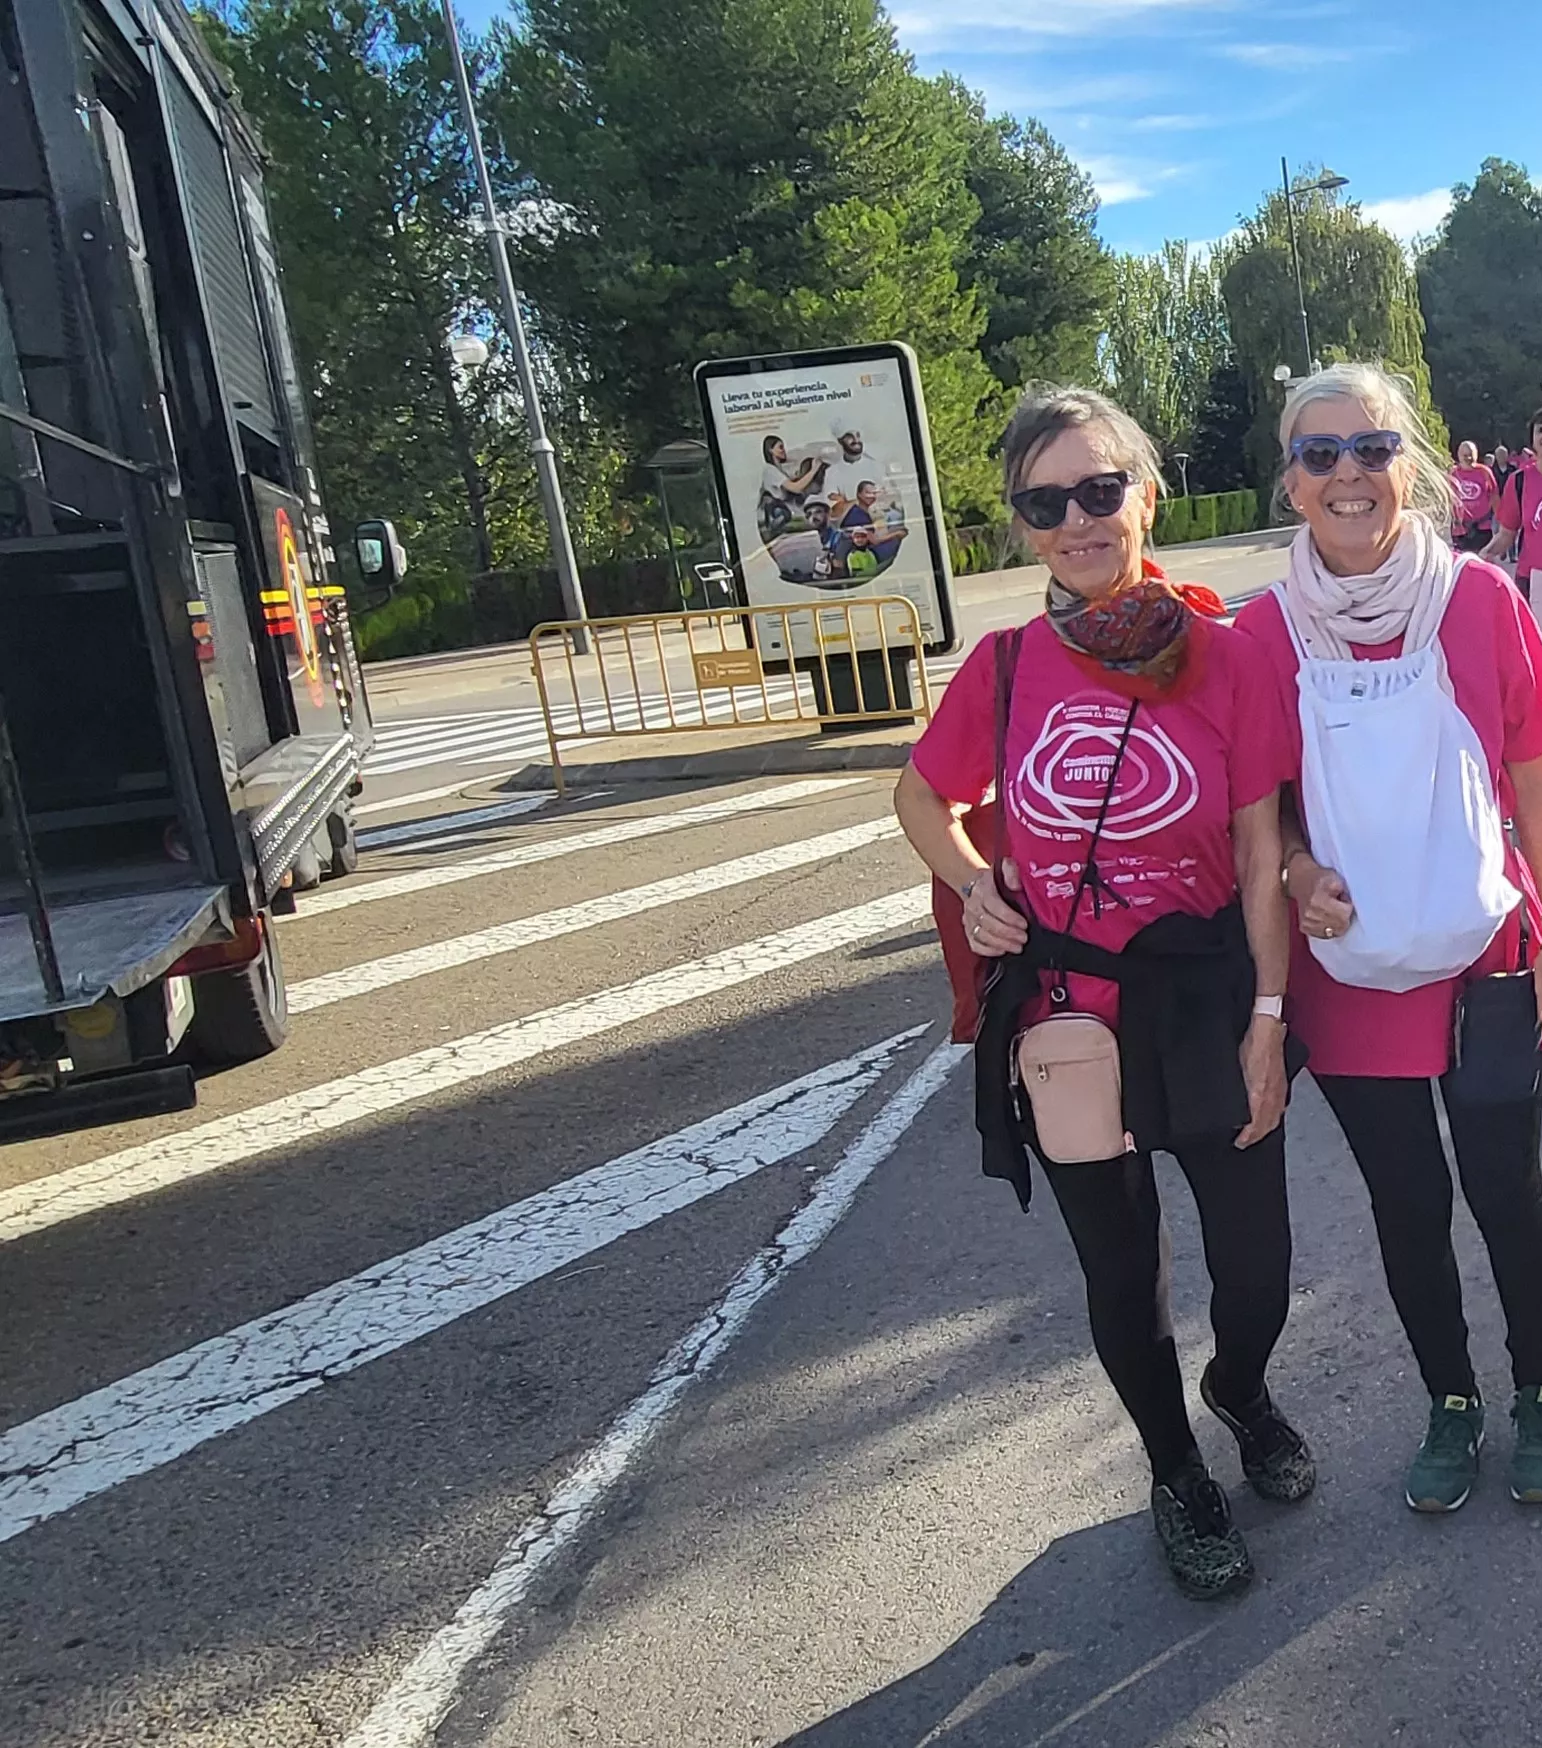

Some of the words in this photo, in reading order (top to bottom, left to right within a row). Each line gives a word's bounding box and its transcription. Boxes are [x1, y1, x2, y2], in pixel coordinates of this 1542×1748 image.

[721, 393, 750, 403] Lleva
[752, 390, 763, 399] tu
[765, 381, 828, 398] experiencia
[723, 400, 762, 414] laboral
[763, 398, 774, 409] al
[776, 394, 825, 408] siguiente
[826, 388, 852, 401] nivel
